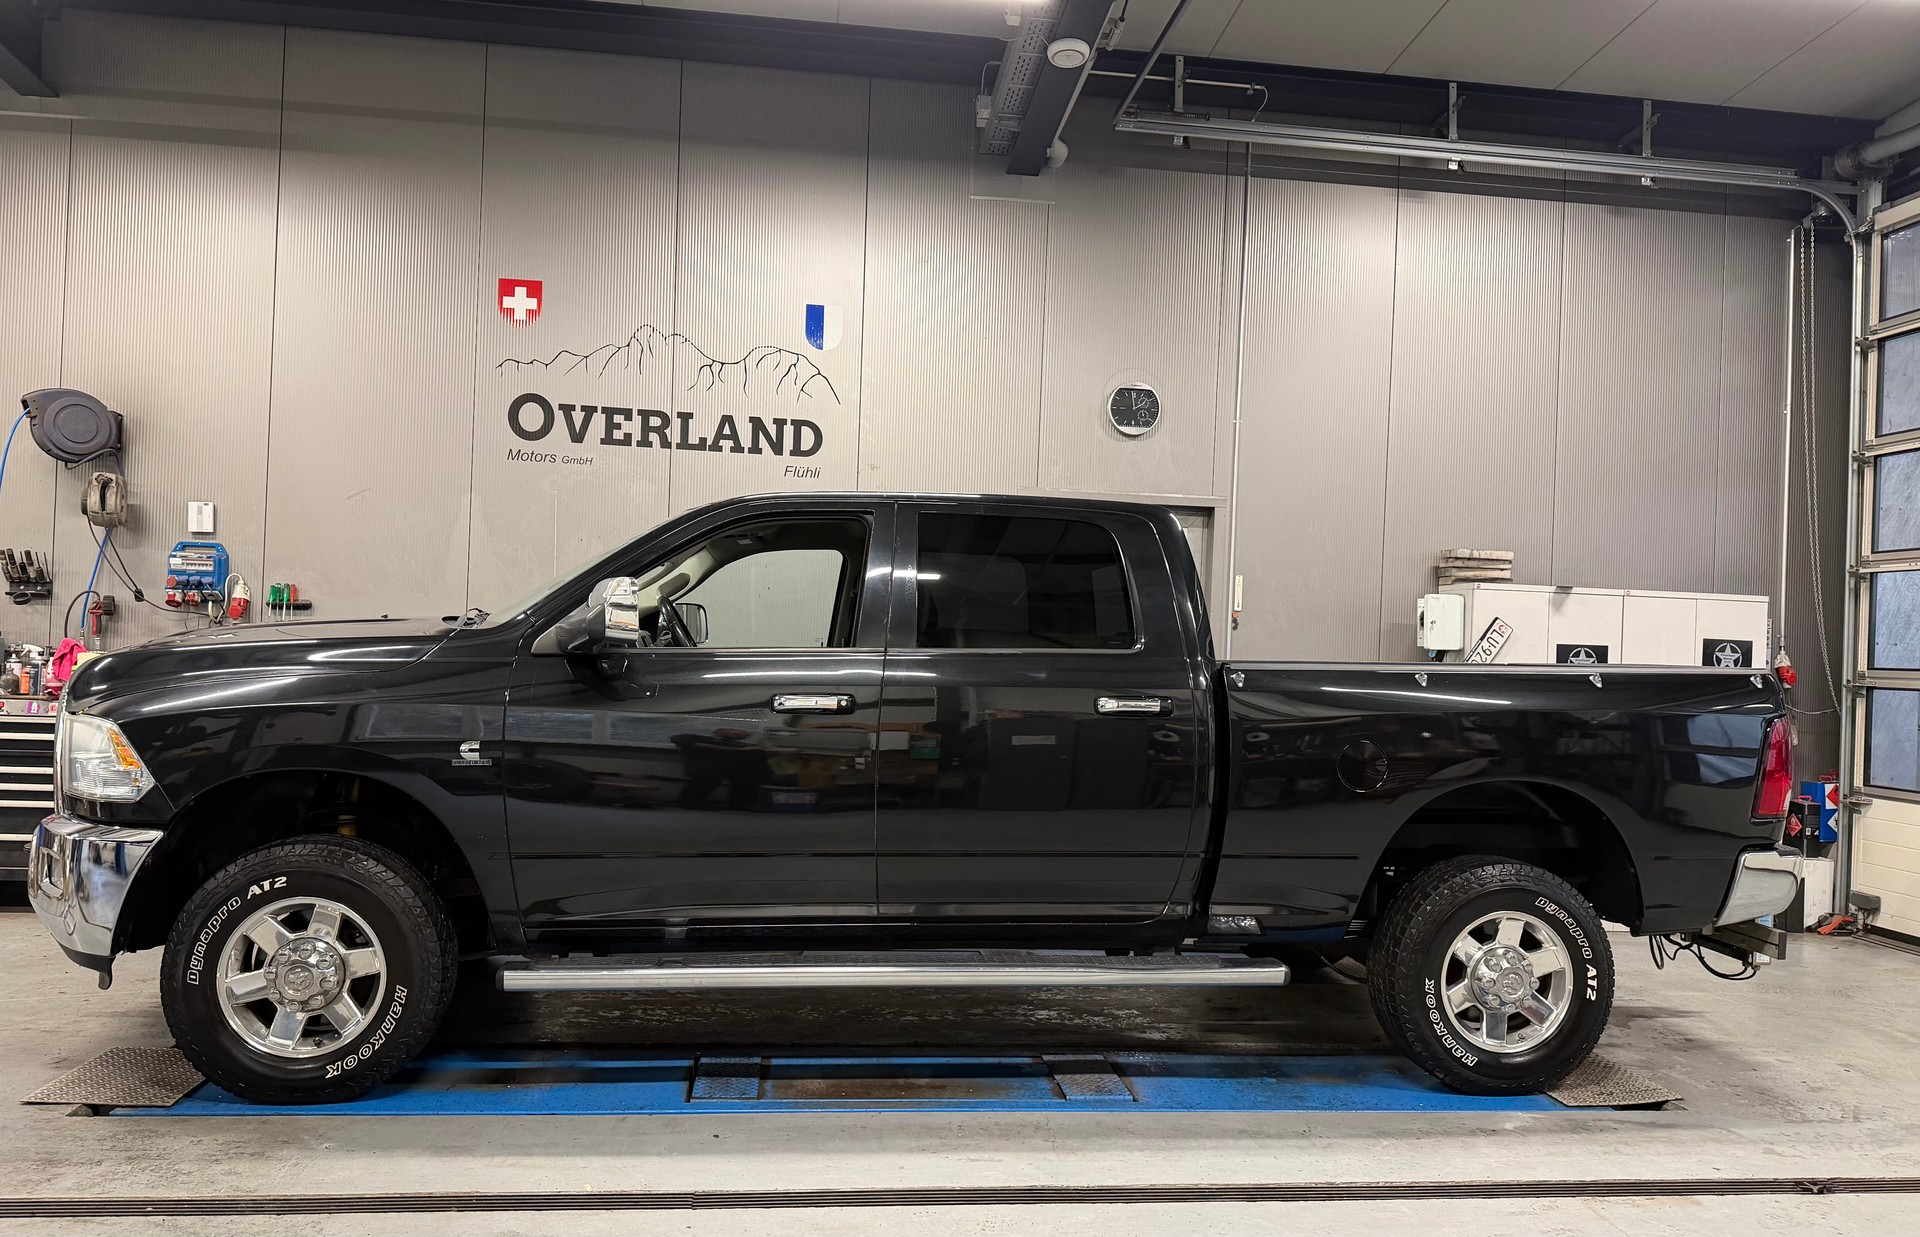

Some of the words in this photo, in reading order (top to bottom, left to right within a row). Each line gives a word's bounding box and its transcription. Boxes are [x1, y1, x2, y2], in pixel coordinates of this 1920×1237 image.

[506, 448, 557, 464] Motors
[561, 455, 594, 466] GmbH
[507, 392, 823, 458] OVERLAND
[783, 465, 821, 480] Flühli
[186, 896, 241, 985] Dynapro
[247, 876, 288, 900] AT2
[1534, 896, 1593, 959] Dynapro
[1585, 963, 1598, 1001] AT2
